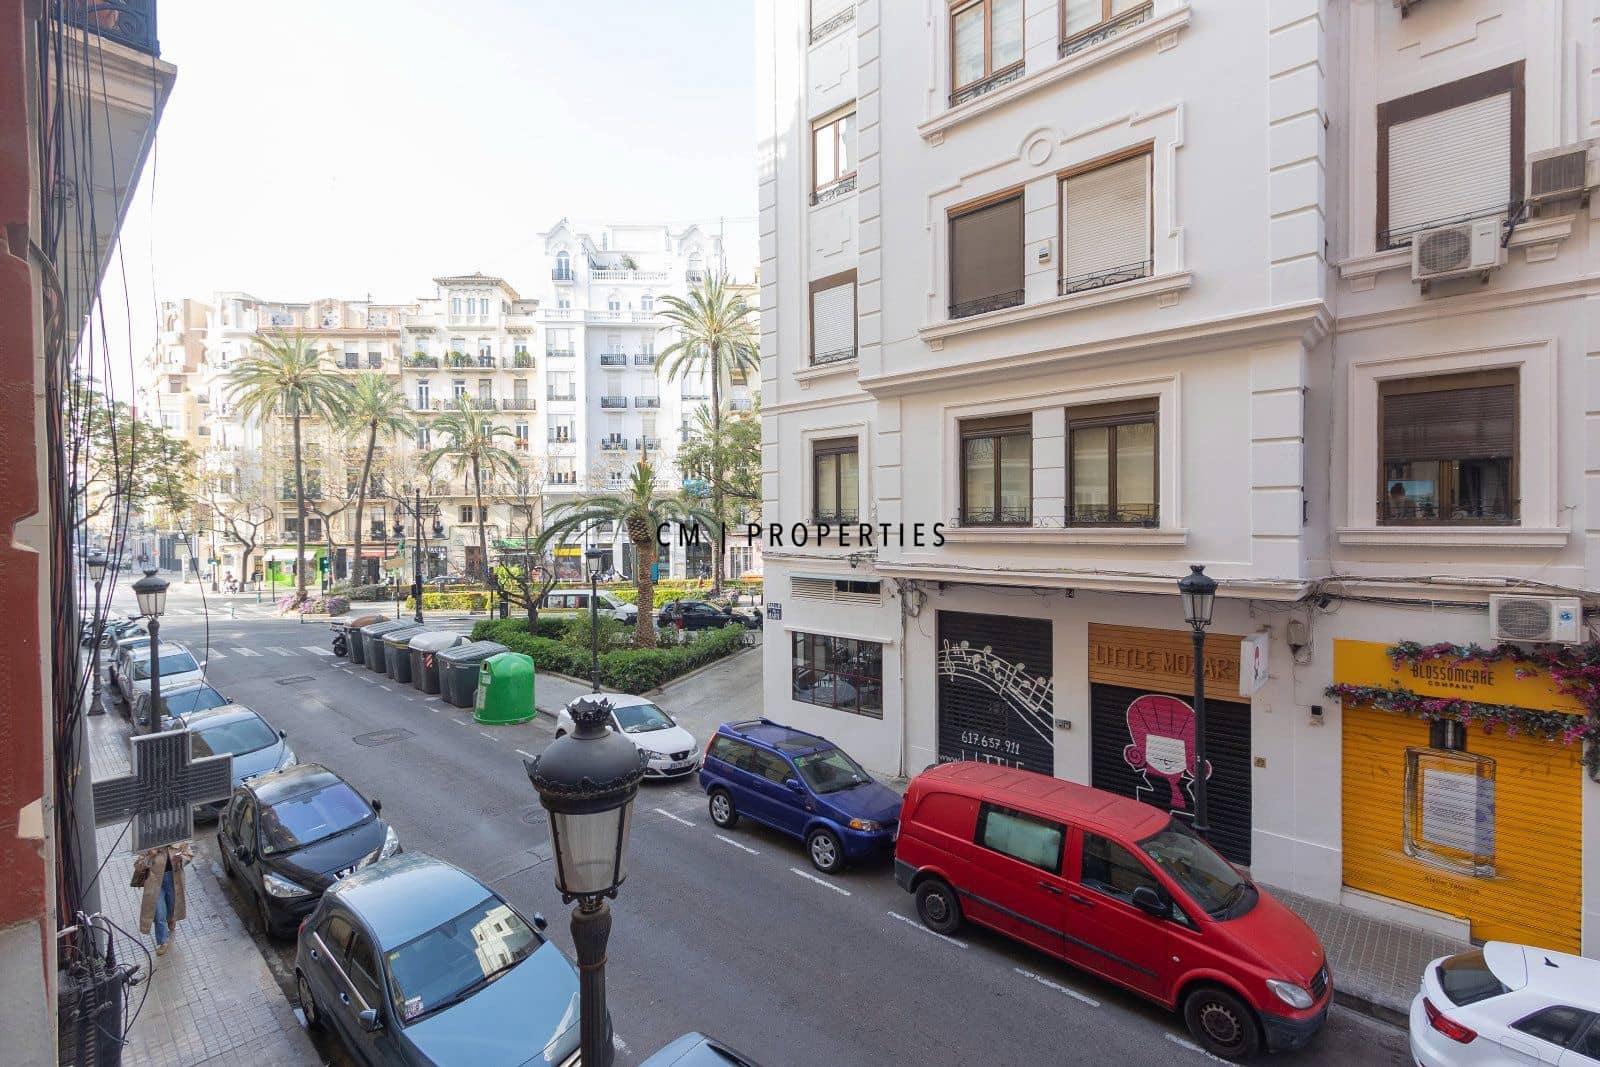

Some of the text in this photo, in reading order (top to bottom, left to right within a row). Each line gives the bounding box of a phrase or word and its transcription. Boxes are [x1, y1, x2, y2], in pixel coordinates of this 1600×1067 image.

[1161, 648, 1240, 681] MOART
[1410, 664, 1495, 686] BLOSSOMCARE
[1427, 680, 1474, 690] COMPANY
